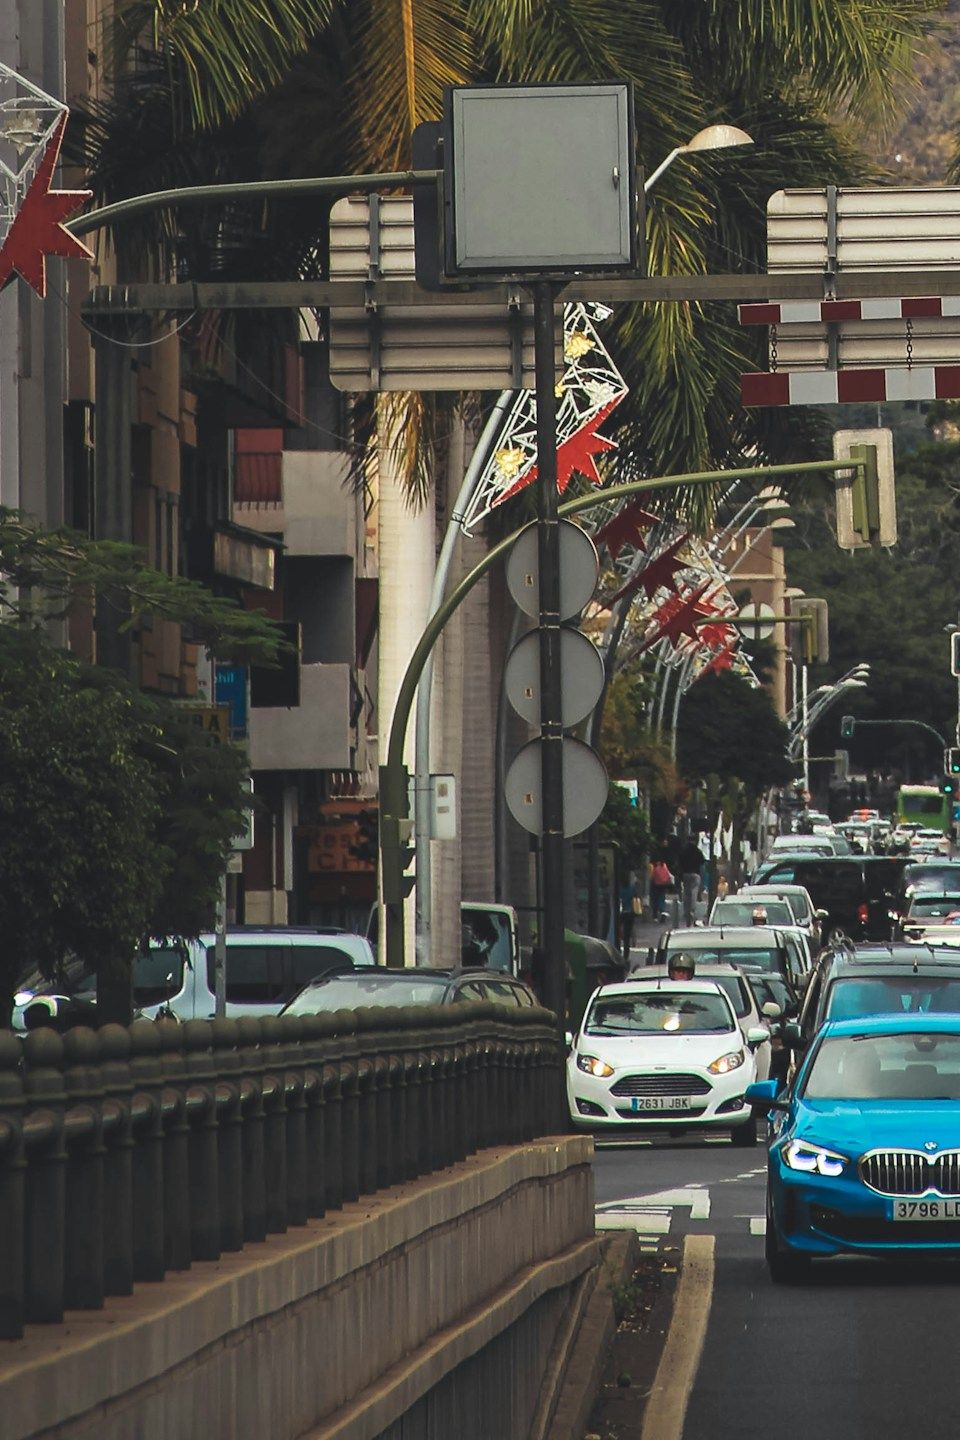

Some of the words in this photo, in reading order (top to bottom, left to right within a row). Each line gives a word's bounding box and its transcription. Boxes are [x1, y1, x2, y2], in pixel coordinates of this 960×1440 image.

[639, 1098, 664, 1109] 2631
[669, 1098, 688, 1108] JBK
[898, 1202, 939, 1218] 3796
